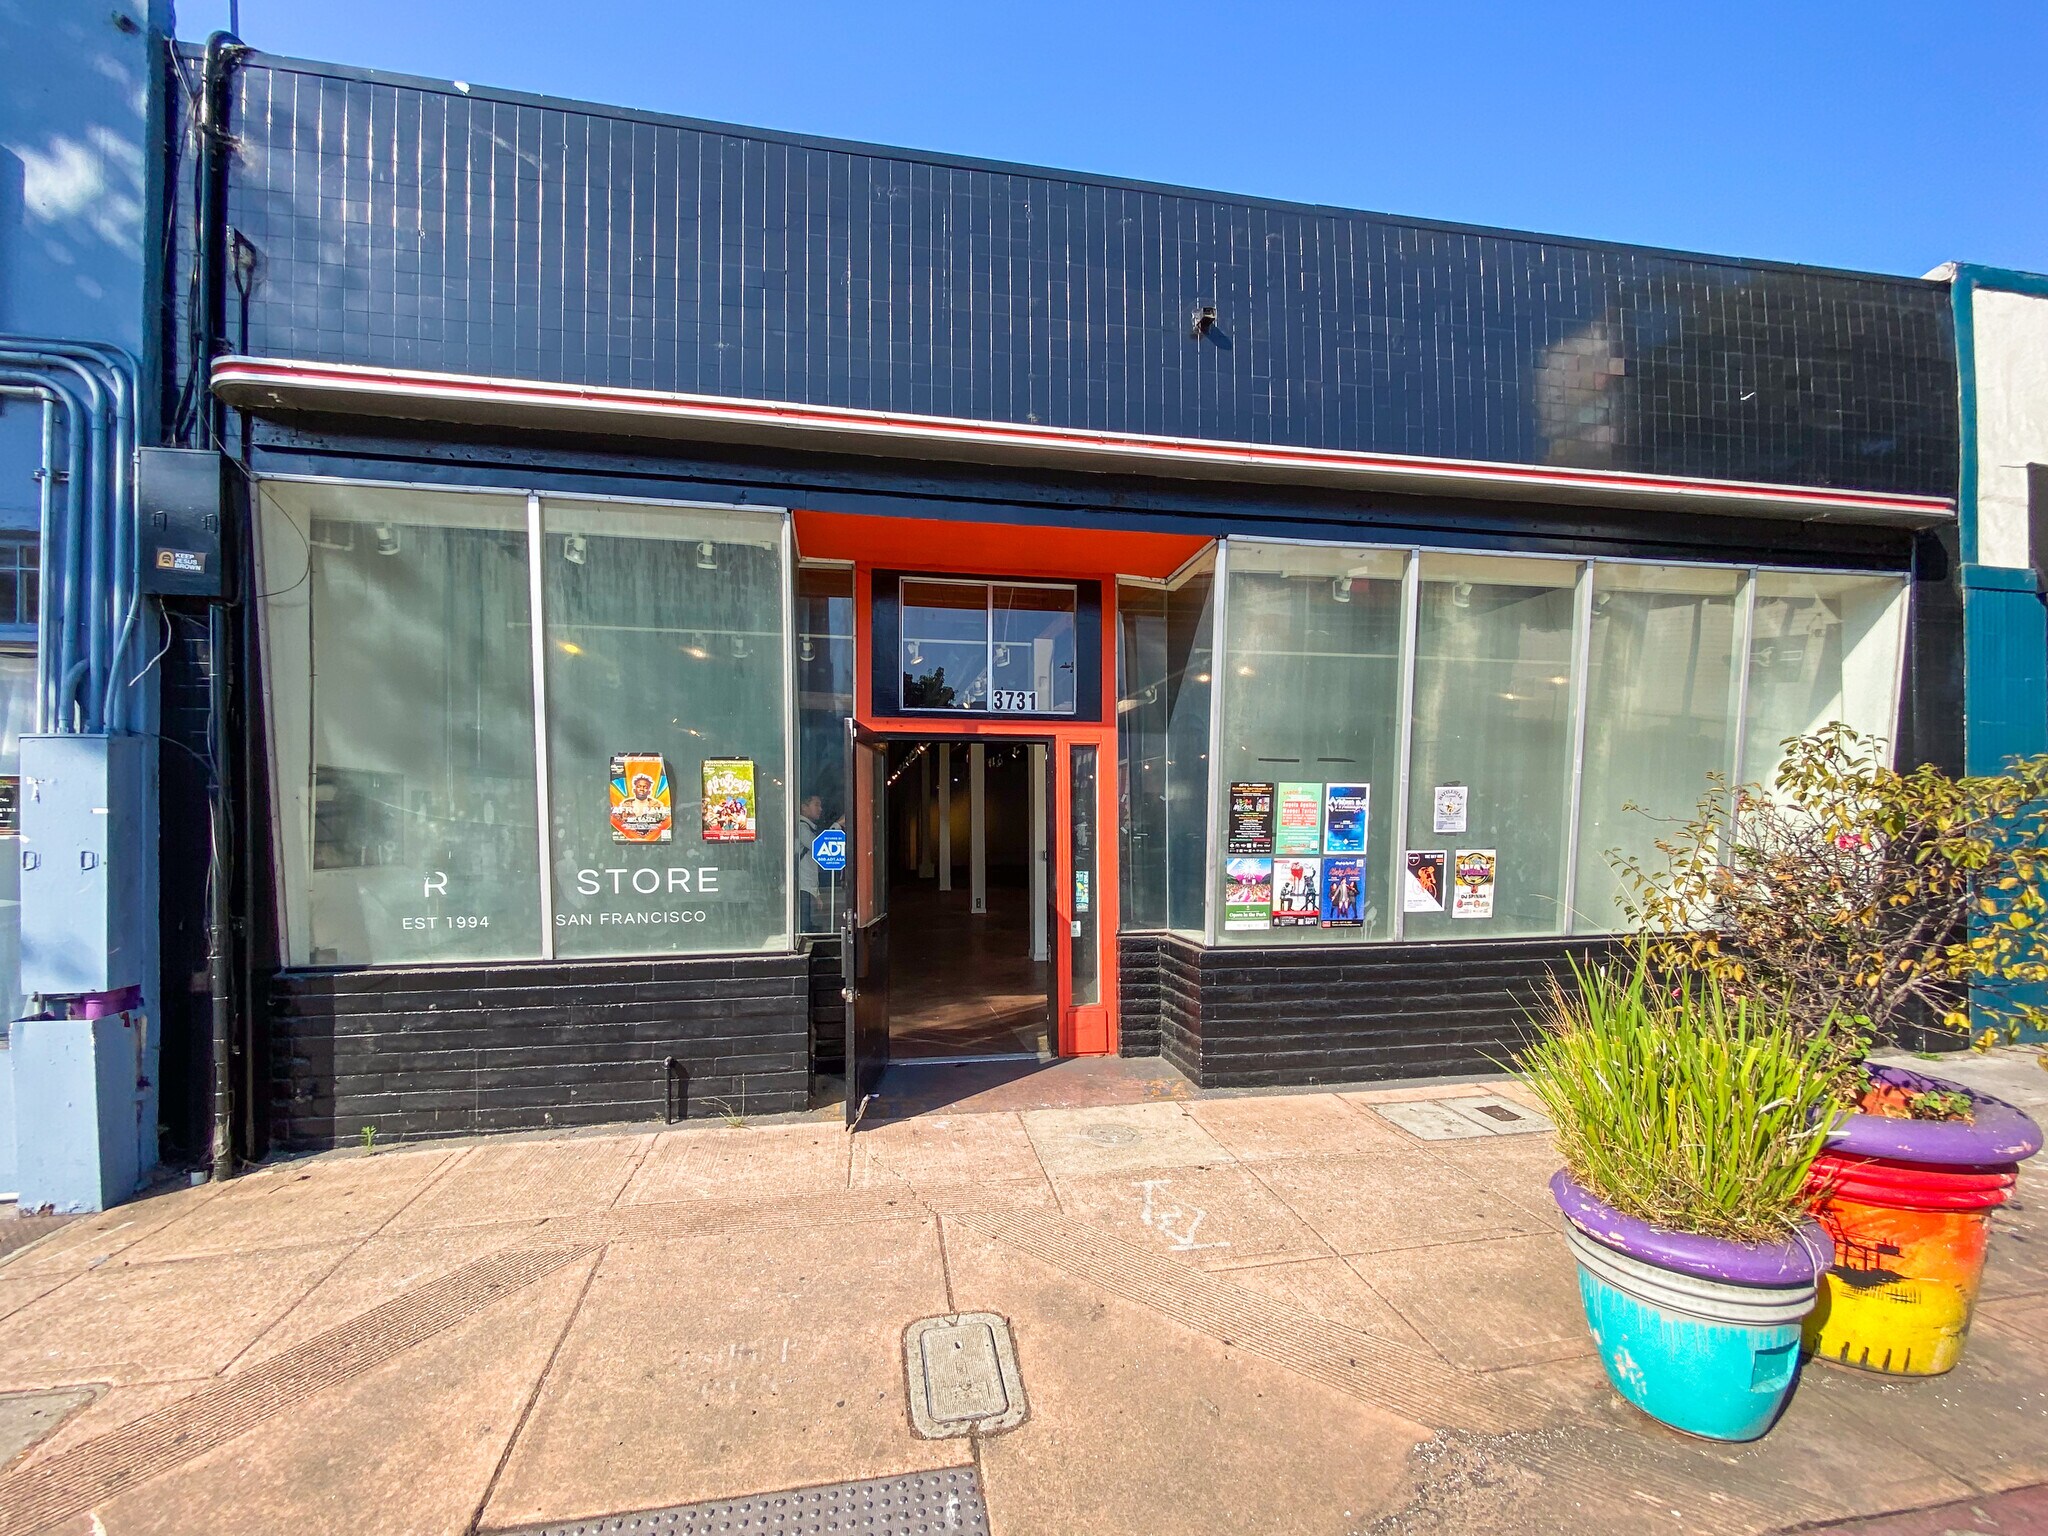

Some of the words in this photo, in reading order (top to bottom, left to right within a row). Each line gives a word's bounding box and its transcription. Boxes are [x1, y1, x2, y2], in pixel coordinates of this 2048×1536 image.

[174, 563, 202, 571] BROWN
[993, 690, 1036, 710] 3731
[817, 842, 845, 856] ADT
[576, 867, 719, 896] STORE
[402, 917, 437, 930] EST
[446, 915, 490, 929] 1994
[555, 913, 592, 927] SAN
[600, 910, 707, 925] FRANCISCO
